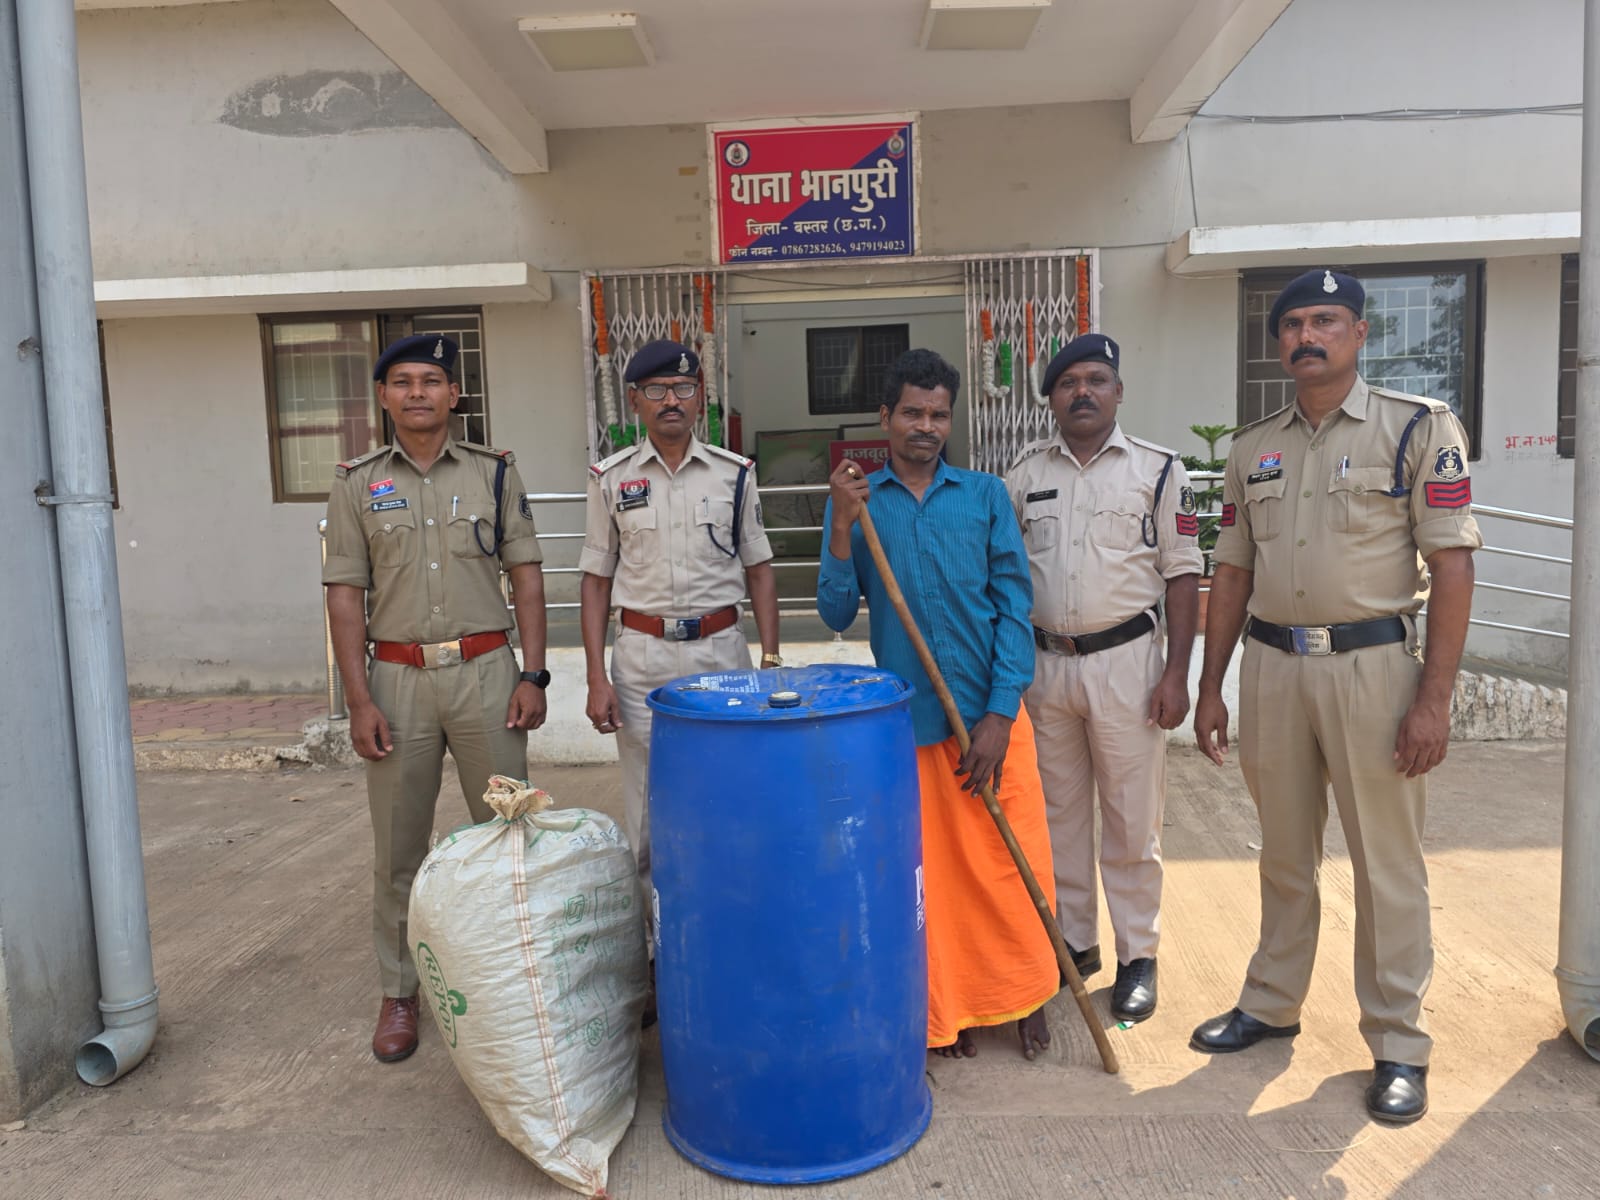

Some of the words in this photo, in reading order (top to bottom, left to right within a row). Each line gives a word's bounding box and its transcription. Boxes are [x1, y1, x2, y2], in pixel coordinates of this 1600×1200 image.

[730, 172, 792, 205] थाना
[800, 158, 899, 213] भानपुरी
[746, 218, 788, 236] जिला-
[793, 220, 829, 234] बस्तर
[728, 244, 748, 257] फोन
[842, 447, 889, 464] मजबूत
